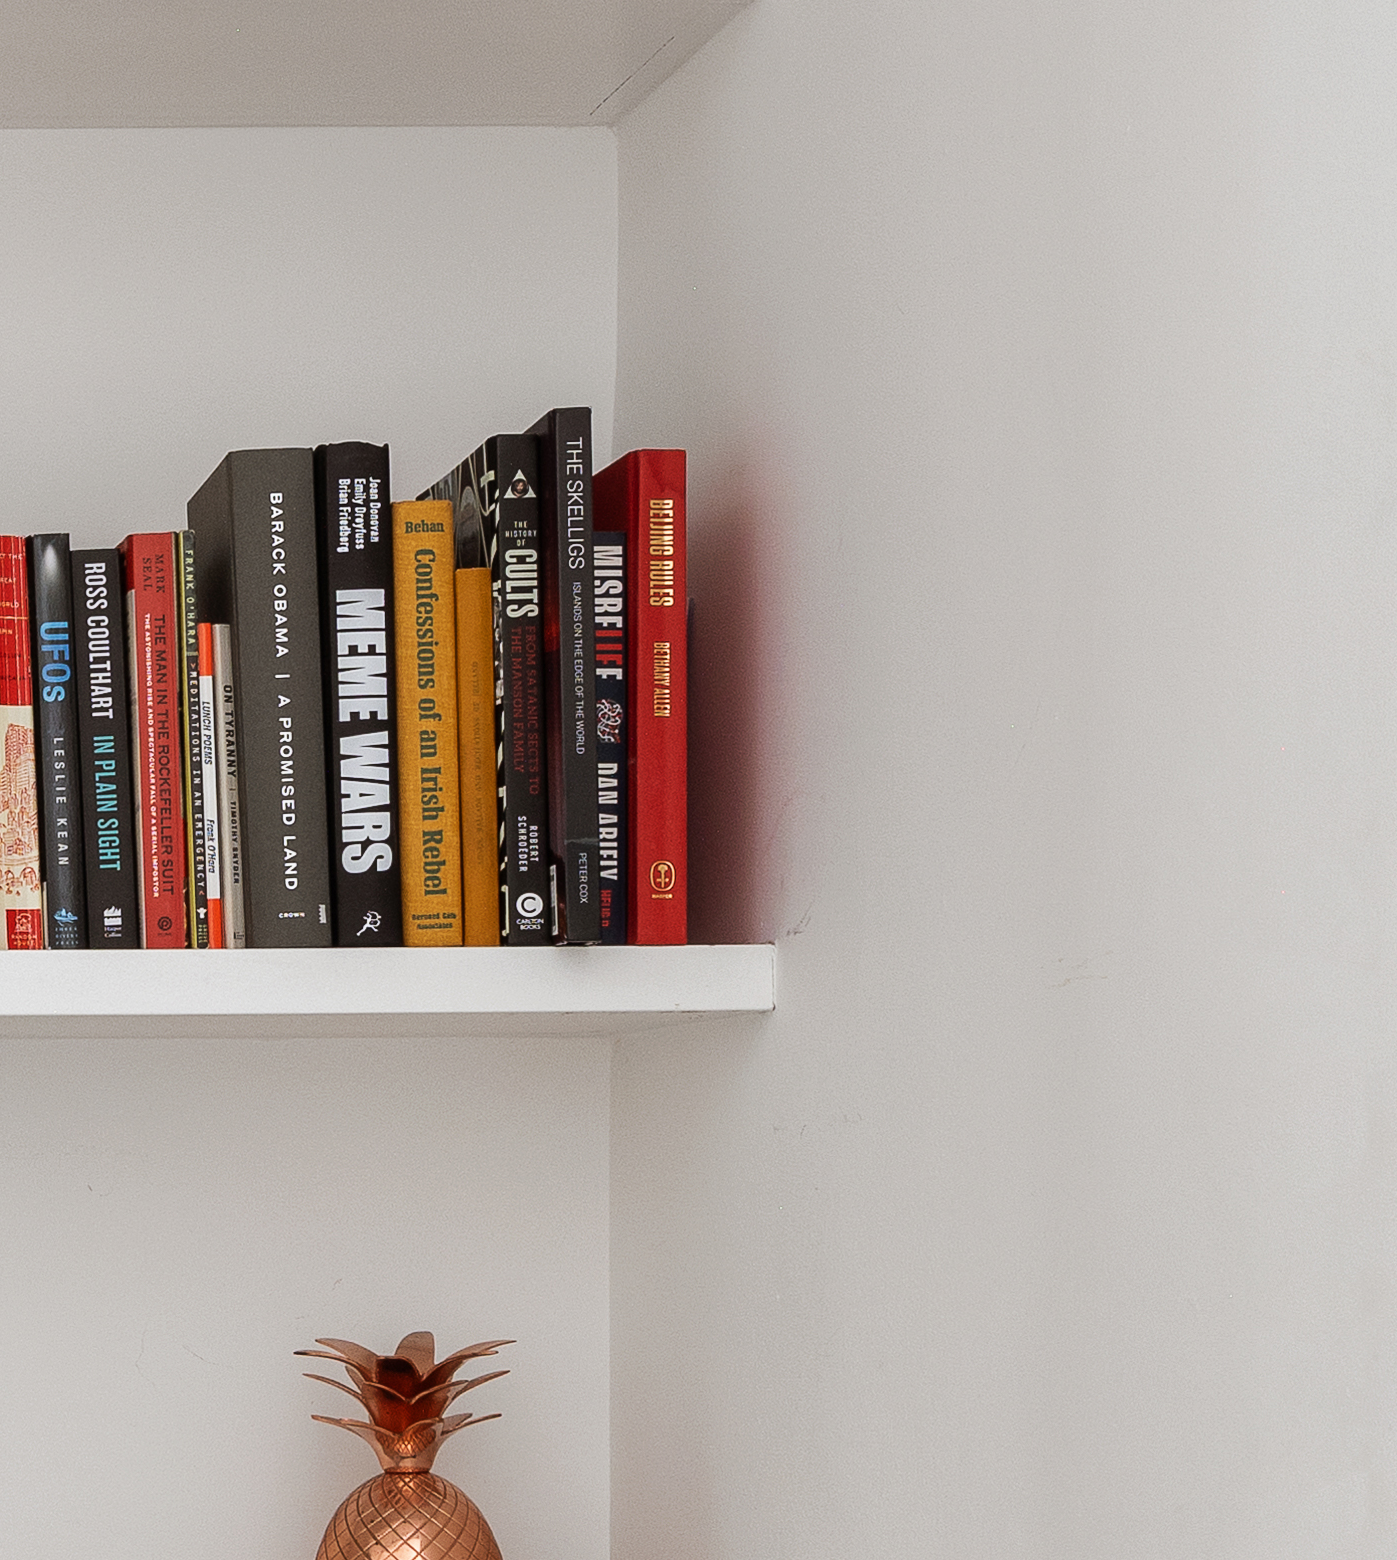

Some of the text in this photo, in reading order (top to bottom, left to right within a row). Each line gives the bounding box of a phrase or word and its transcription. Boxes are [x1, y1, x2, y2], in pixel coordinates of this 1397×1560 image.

[269, 492, 288, 657] BARACK OBAMA
[567, 436, 584, 569] THE SKELLIGS
[650, 499, 674, 606] BEIJING RULES
[85, 563, 112, 719] ROSS COULTHART
[505, 549, 537, 619] CULTS
[39, 622, 71, 703] UFOs
[335, 589, 392, 874] MEME WARS
[278, 695, 298, 890] A PROMISED LAND
